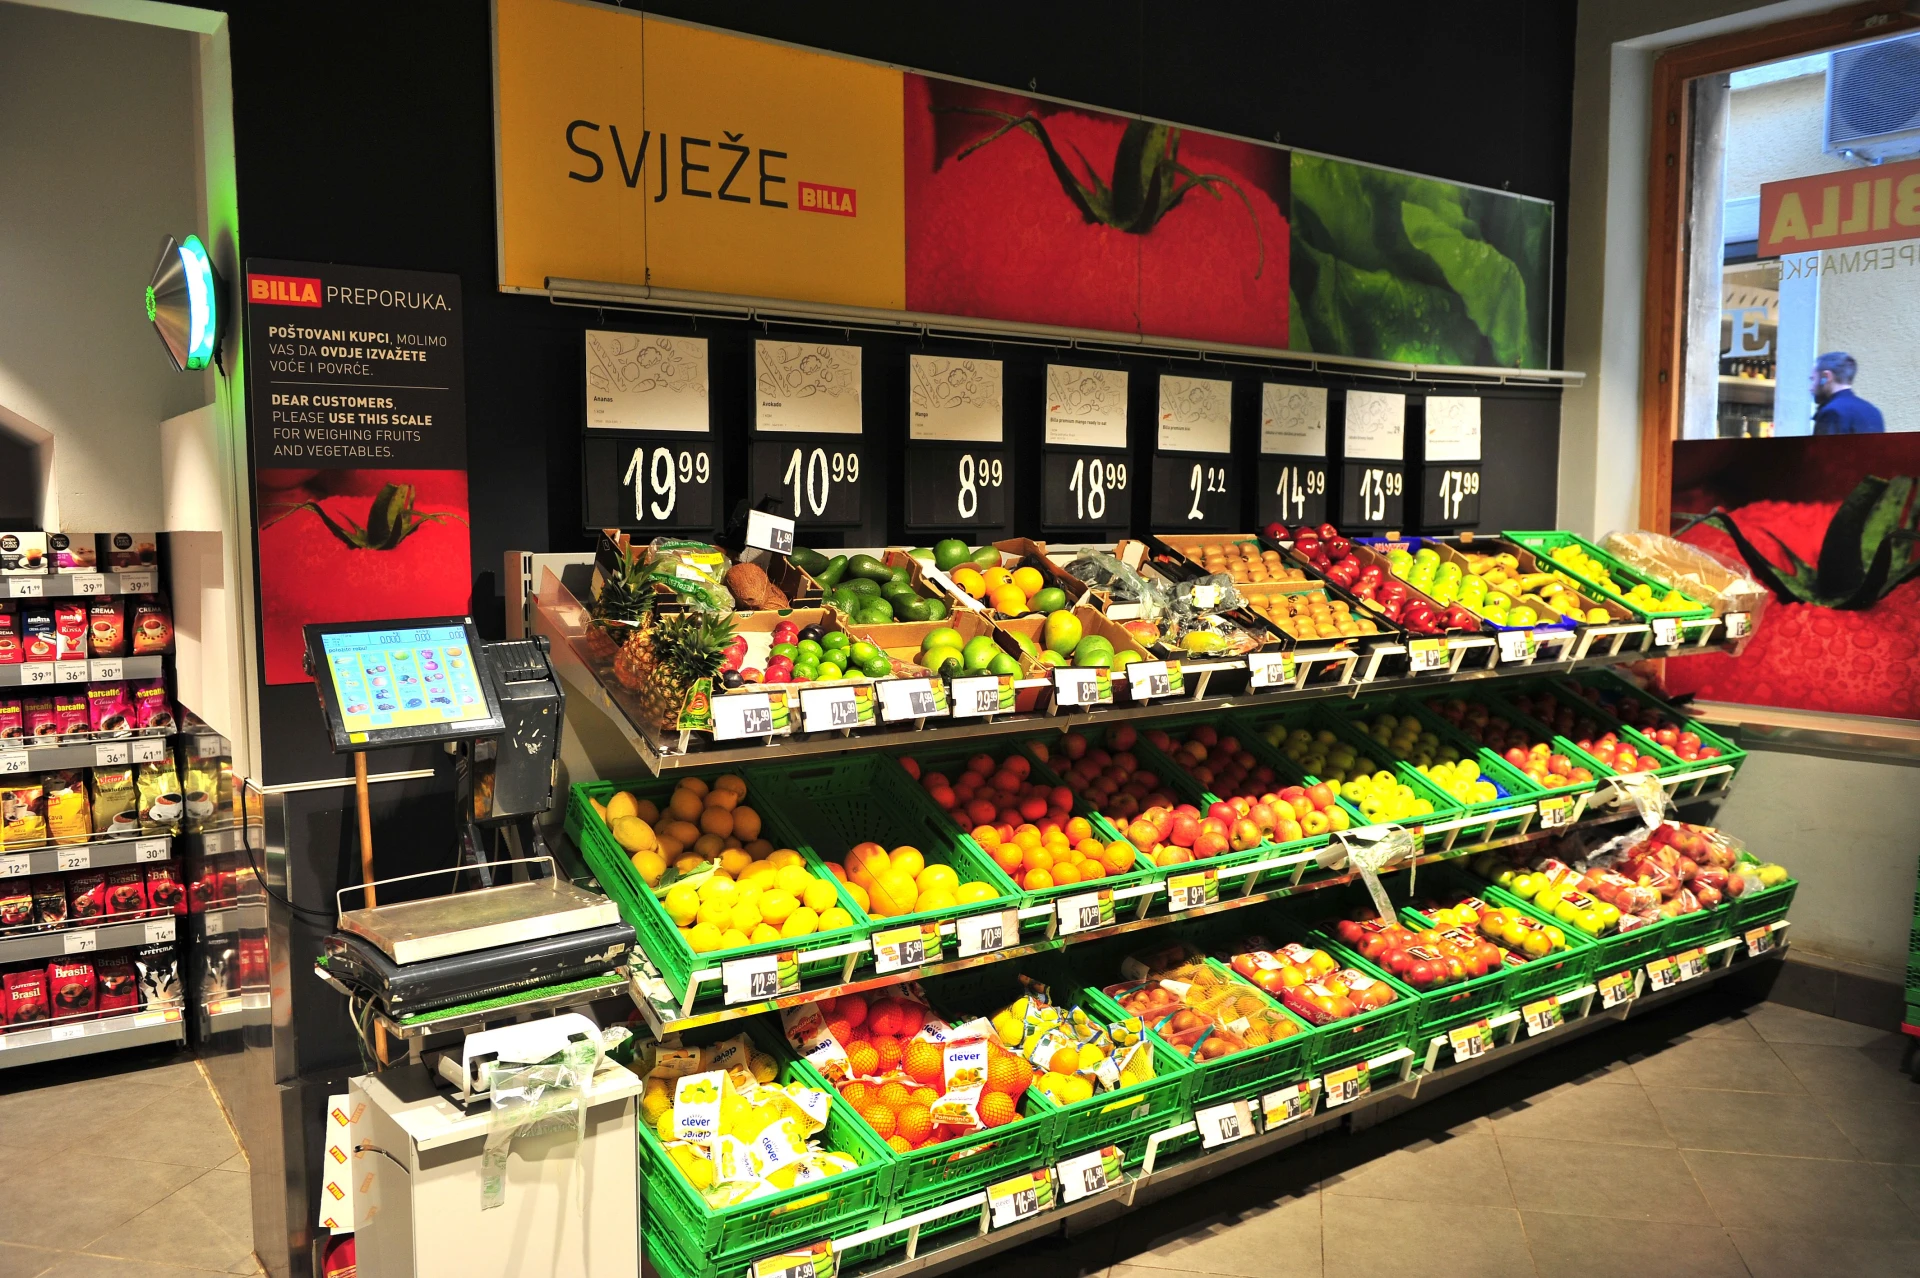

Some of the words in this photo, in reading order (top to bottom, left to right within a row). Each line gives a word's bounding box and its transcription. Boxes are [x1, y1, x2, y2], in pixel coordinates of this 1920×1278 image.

[566, 119, 788, 209] SVJEŽE
[802, 187, 853, 213] BILLA
[251, 279, 318, 303] BILLA
[326, 285, 452, 312] PREPORUKA.
[268, 323, 346, 342] POŠTOVANI
[349, 331, 393, 346] KUPCI,
[396, 333, 448, 347] MOLIMO
[268, 343, 295, 356] VAS
[299, 345, 318, 356] DA
[320, 346, 363, 359] OVDJE
[366, 347, 427, 362] IZVAŽETE
[269, 358, 306, 373] VOĆE
[309, 363, 313, 373] I
[318, 361, 374, 376] POVRĆE.
[271, 394, 309, 406] DEAR
[312, 395, 397, 411] CUSTOMERS,
[593, 395, 613, 403] Ananas
[272, 411, 325, 423] PLEASE
[328, 412, 355, 424] USE
[358, 413, 389, 425] THIS
[391, 414, 433, 426] SCALE
[273, 428, 301, 440] FOR
[303, 428, 372, 441] WEIGHING
[376, 430, 421, 442] FRUITS
[273, 445, 303, 456] AND
[306, 445, 395, 458] VEGETABLES.
[97, 956, 129, 967] Brasil
[54, 965, 87, 979] Brasil
[11, 987, 41, 1000] Brasil
[949, 1052, 980, 1062] clever
[681, 1117, 711, 1126] clever
[683, 1130, 711, 1139] clever
[762, 1137, 779, 1162] clever
